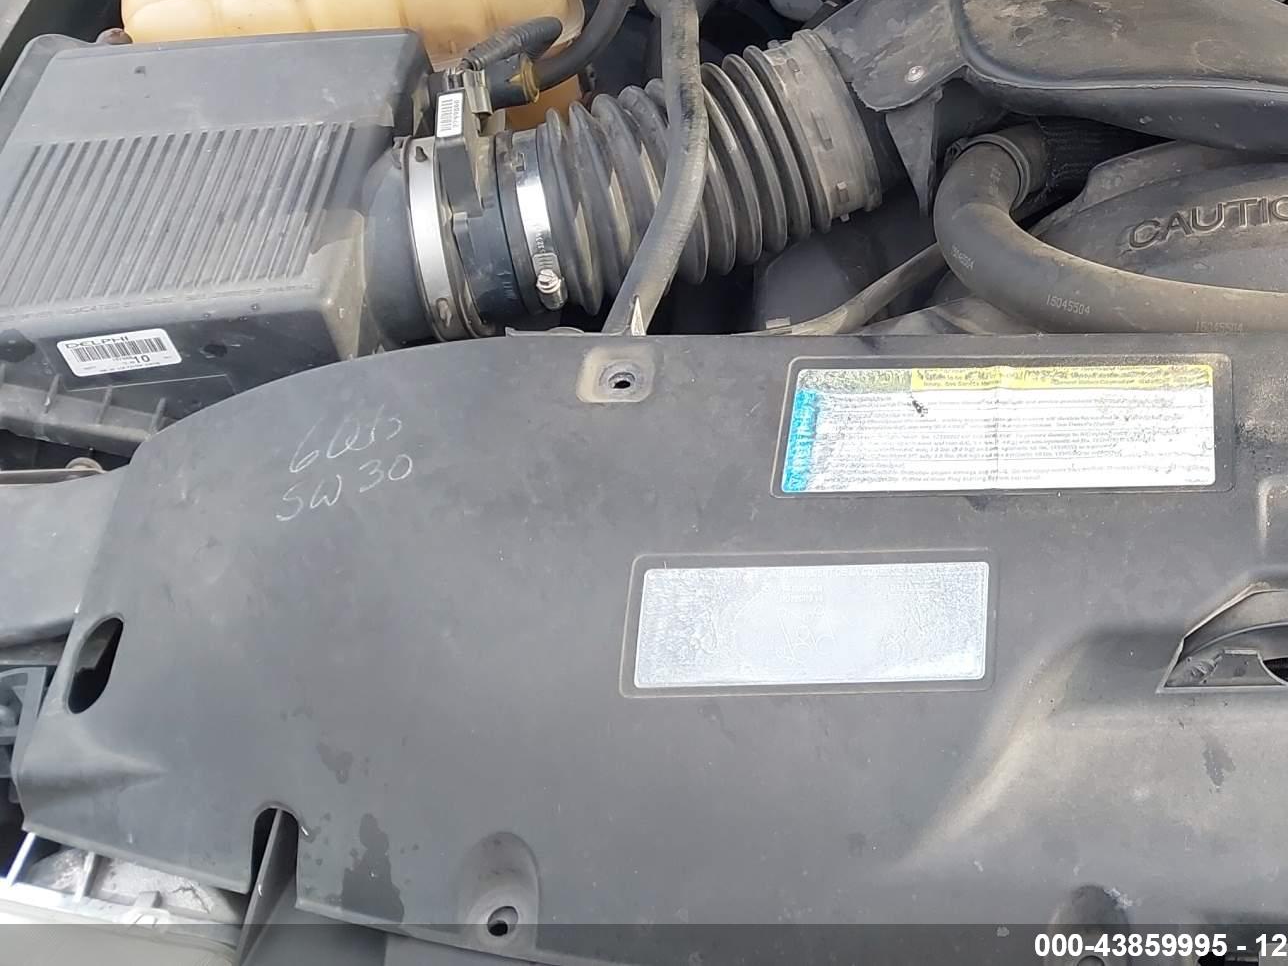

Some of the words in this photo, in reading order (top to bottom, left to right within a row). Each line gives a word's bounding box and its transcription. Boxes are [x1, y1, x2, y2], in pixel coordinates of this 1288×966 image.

[64, 335, 130, 349] DELPHI
[134, 354, 151, 365] 10
[358, 454, 413, 493] 30
